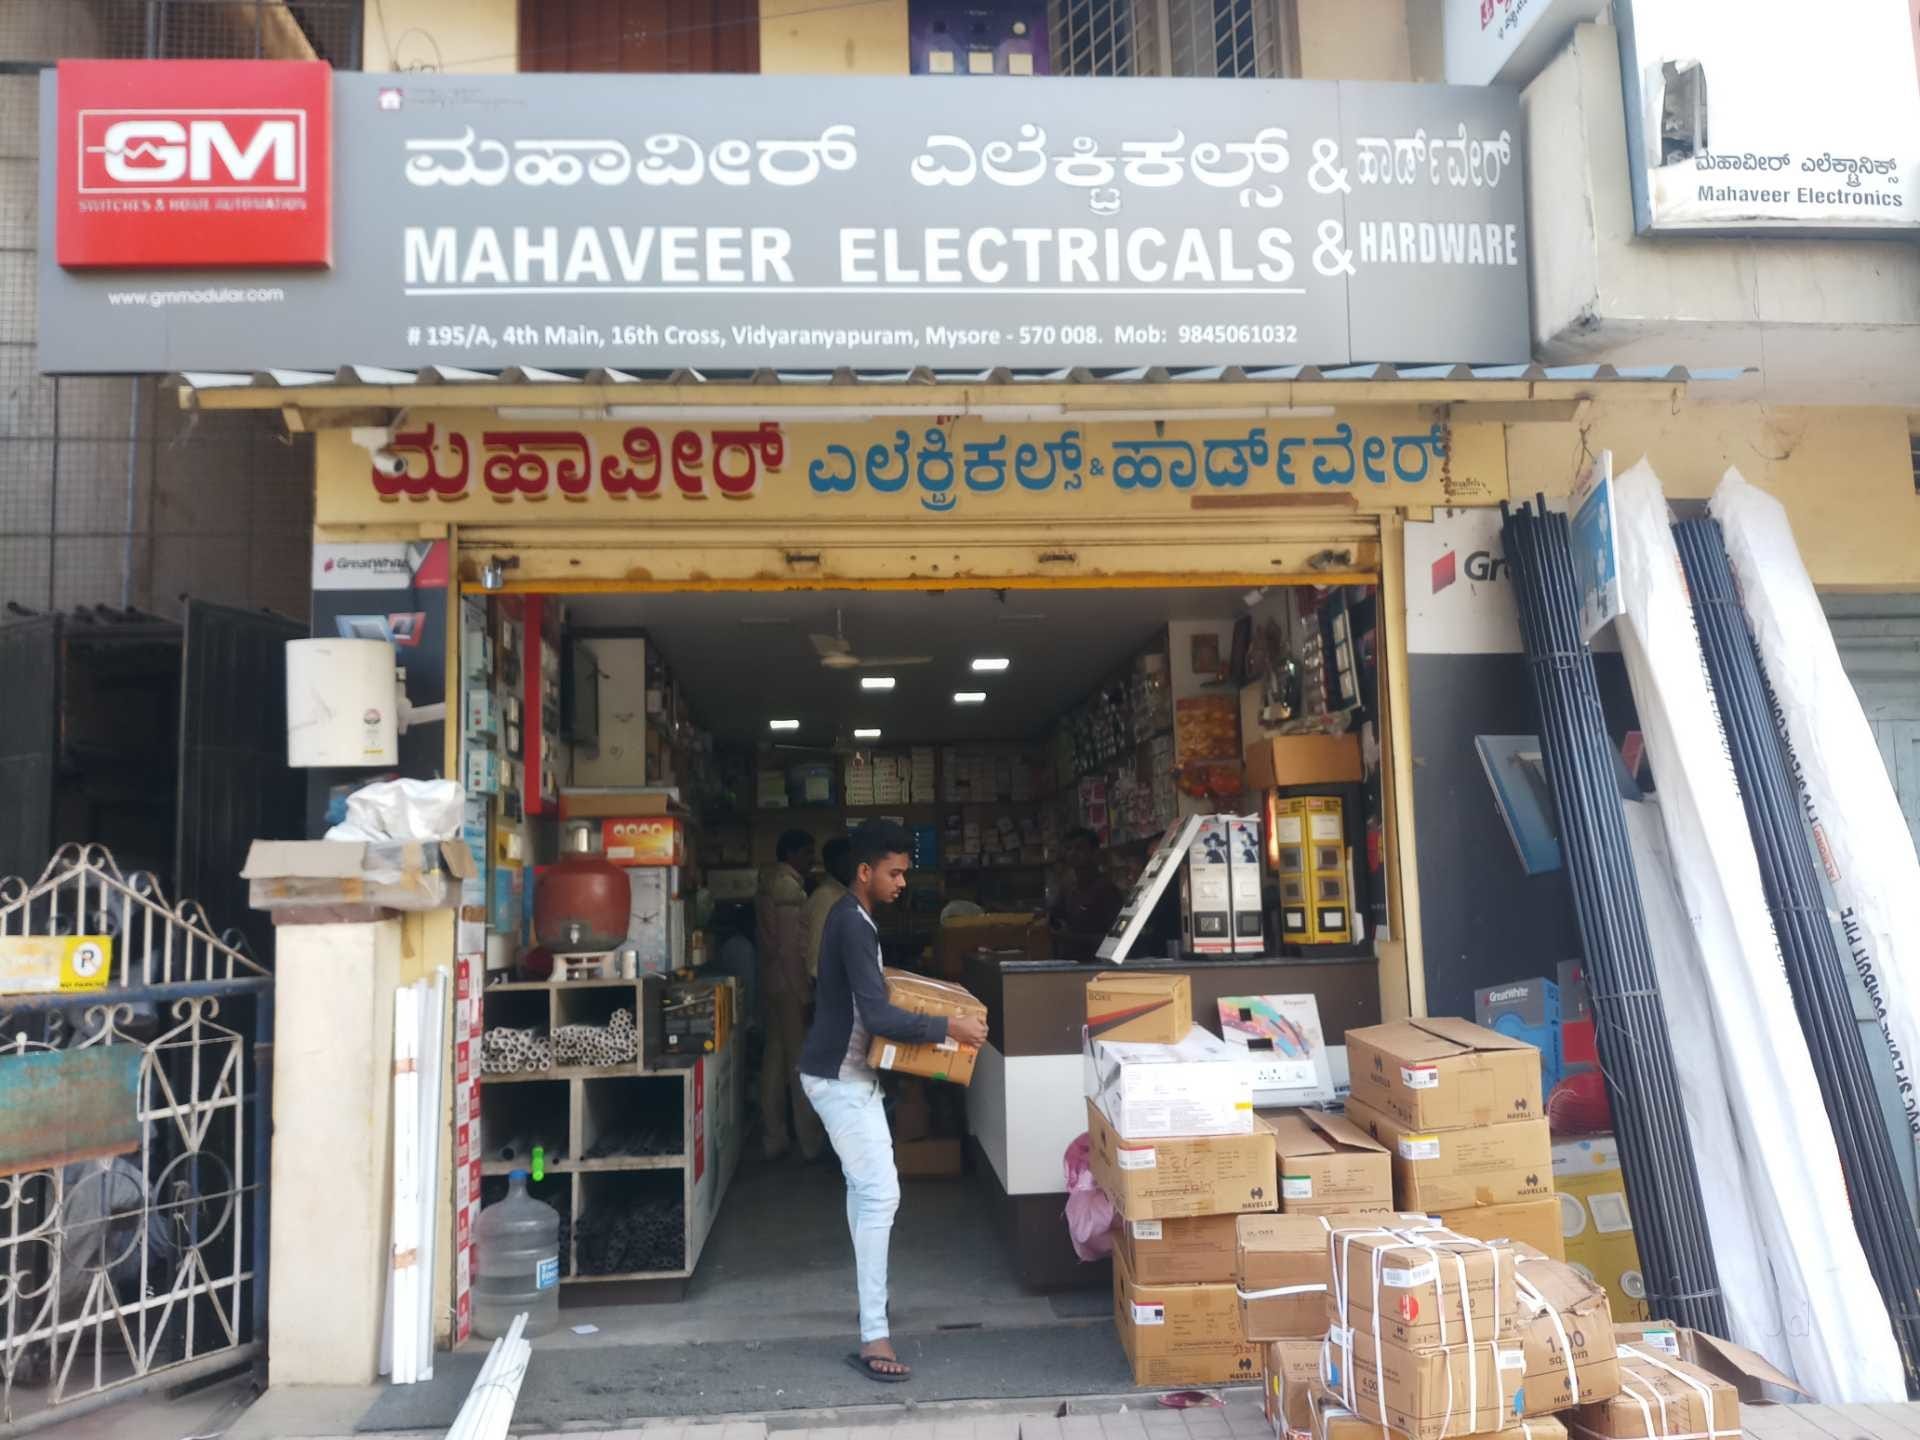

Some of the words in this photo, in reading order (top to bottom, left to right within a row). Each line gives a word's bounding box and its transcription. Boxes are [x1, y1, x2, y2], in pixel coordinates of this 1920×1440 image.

[103, 120, 298, 182] GM
[1695, 152, 1791, 172] ಮಹಾವೀರ್
[405, 125, 857, 187] ಮಹಾವೀರ್
[911, 124, 1290, 215] ಎಲೆಕ್ಟ್ರಿಕಲ್ಸ್
[1307, 138, 1352, 194] &
[1698, 184, 1791, 204] Mahaveer
[1797, 186, 1903, 208] Electronics
[404, 227, 793, 283] MAHAVEER
[839, 226, 1295, 283] ELECTRICALS
[1311, 219, 1357, 276] &
[1359, 221, 1518, 266] HARDWARE
[107, 286, 285, 308] www.gmmodular.com
[407, 327, 421, 346] #
[427, 324, 497, 349] 195/A,
[503, 324, 539, 345] 4th
[545, 325, 605, 348] Main,
[612, 324, 659, 345] 16th
[664, 326, 726, 348] Cross,
[731, 324, 919, 349] Vidyaranyapuram,
[926, 326, 1000, 349] Mysore
[1019, 326, 1056, 345] 570
[1061, 326, 1103, 345] 008.
[1114, 325, 1167, 345] Mob:
[1178, 325, 1297, 344] 9845061032
[372, 422, 784, 499] ಮಹಾವೀರ್
[1089, 456, 1105, 477] &
[1463, 550, 1510, 582] Gr
[1507, 1111, 1535, 1120] HAVELL
[1553, 1388, 1593, 1404] HAVLS
